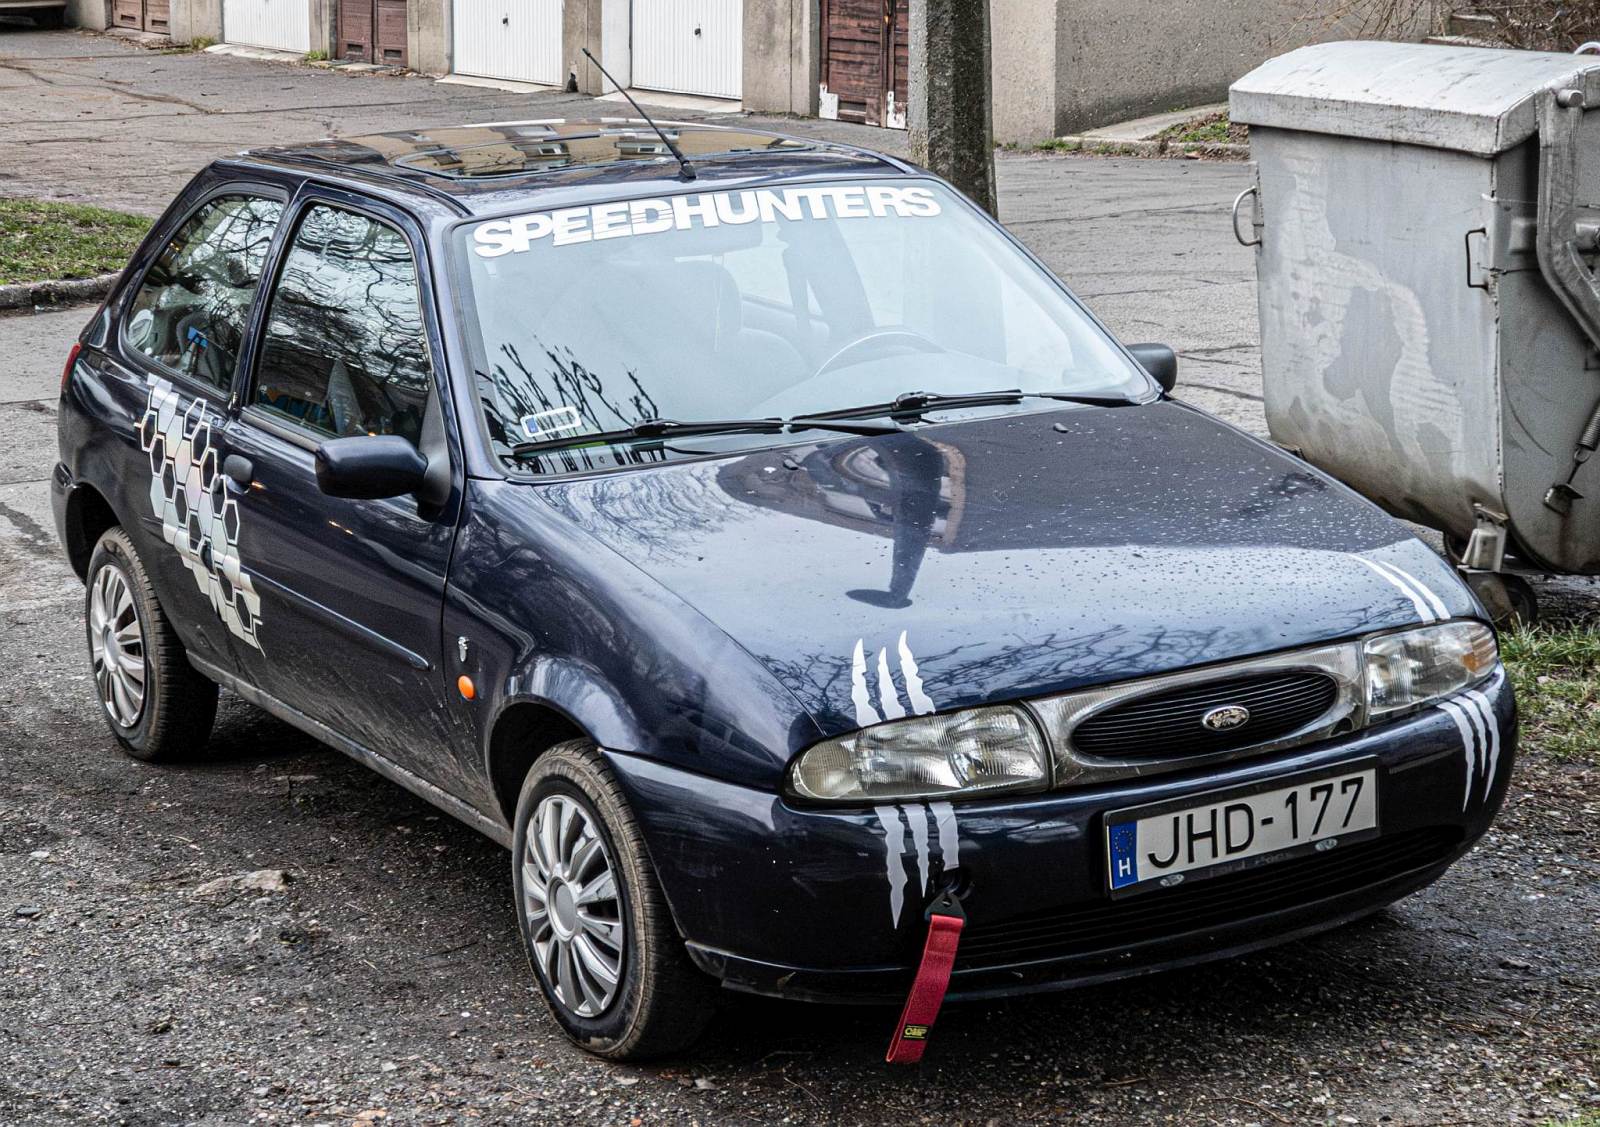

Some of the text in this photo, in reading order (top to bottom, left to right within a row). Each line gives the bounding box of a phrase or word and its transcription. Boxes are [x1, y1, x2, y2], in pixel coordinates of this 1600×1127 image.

[473, 185, 943, 258] SPEEDHUNTERS
[1147, 776, 1365, 869] JHD-177
[1118, 858, 1131, 878] H
